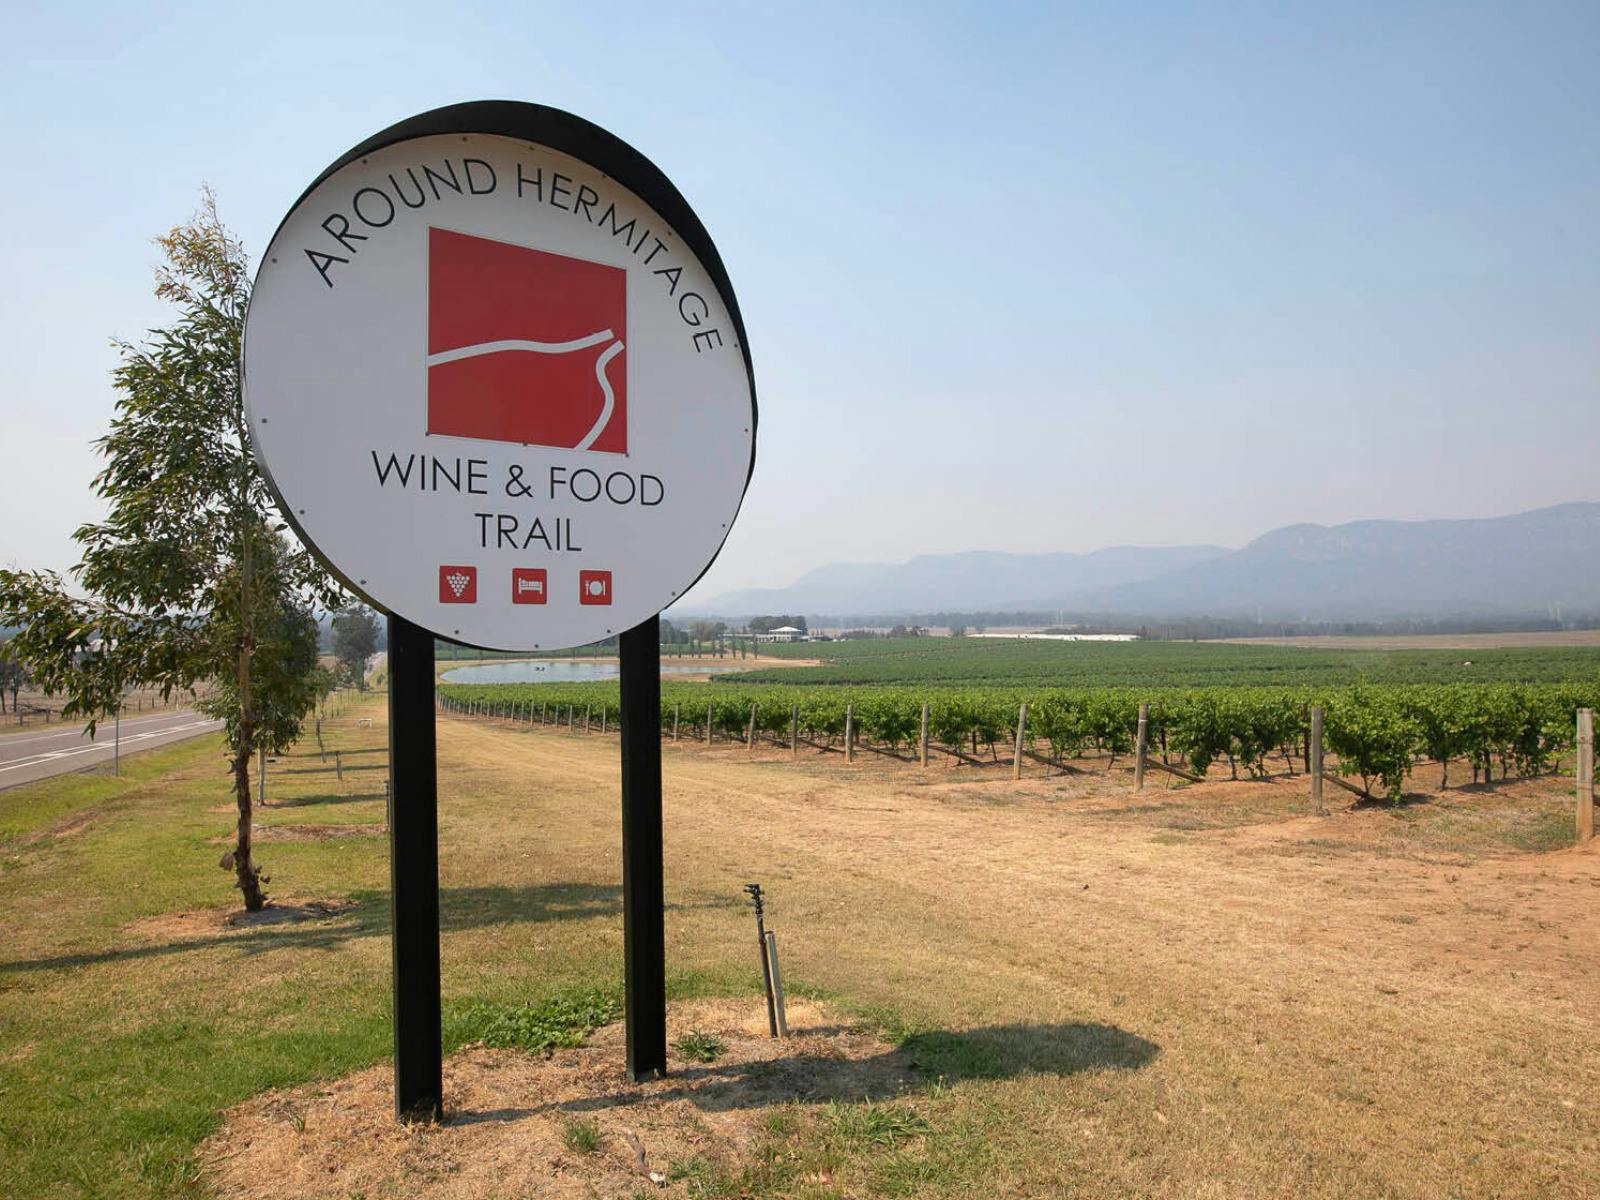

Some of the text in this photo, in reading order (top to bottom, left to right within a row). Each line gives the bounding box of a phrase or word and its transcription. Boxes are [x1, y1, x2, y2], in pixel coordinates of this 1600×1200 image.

[303, 158, 723, 353] AROUND HERMITAGE
[372, 450, 665, 506] WINE & FOOD
[475, 513, 582, 551] TRAIL
